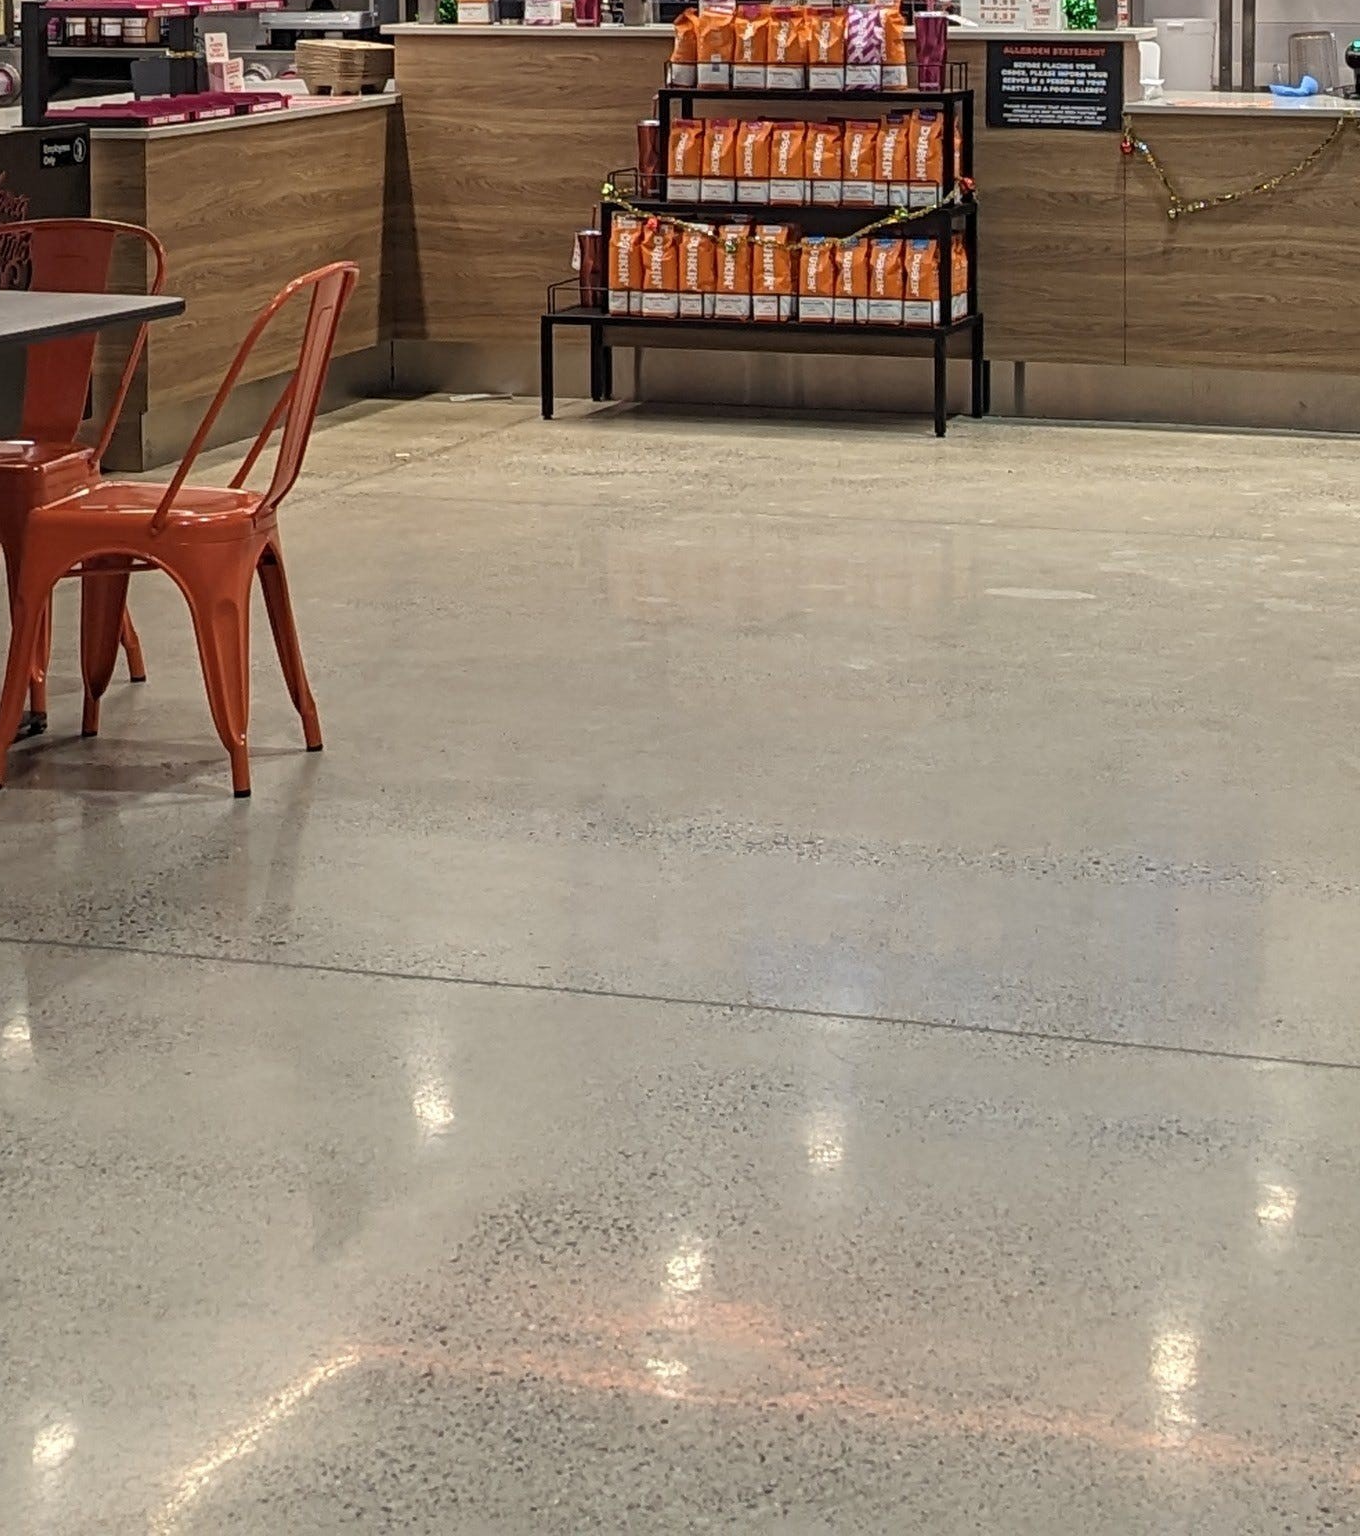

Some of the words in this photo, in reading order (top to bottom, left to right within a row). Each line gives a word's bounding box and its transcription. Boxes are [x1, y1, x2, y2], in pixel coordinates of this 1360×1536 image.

[1003, 47, 1050, 55] ALLERGEN
[43, 142, 71, 154] Employees
[43, 156, 56, 166] Only
